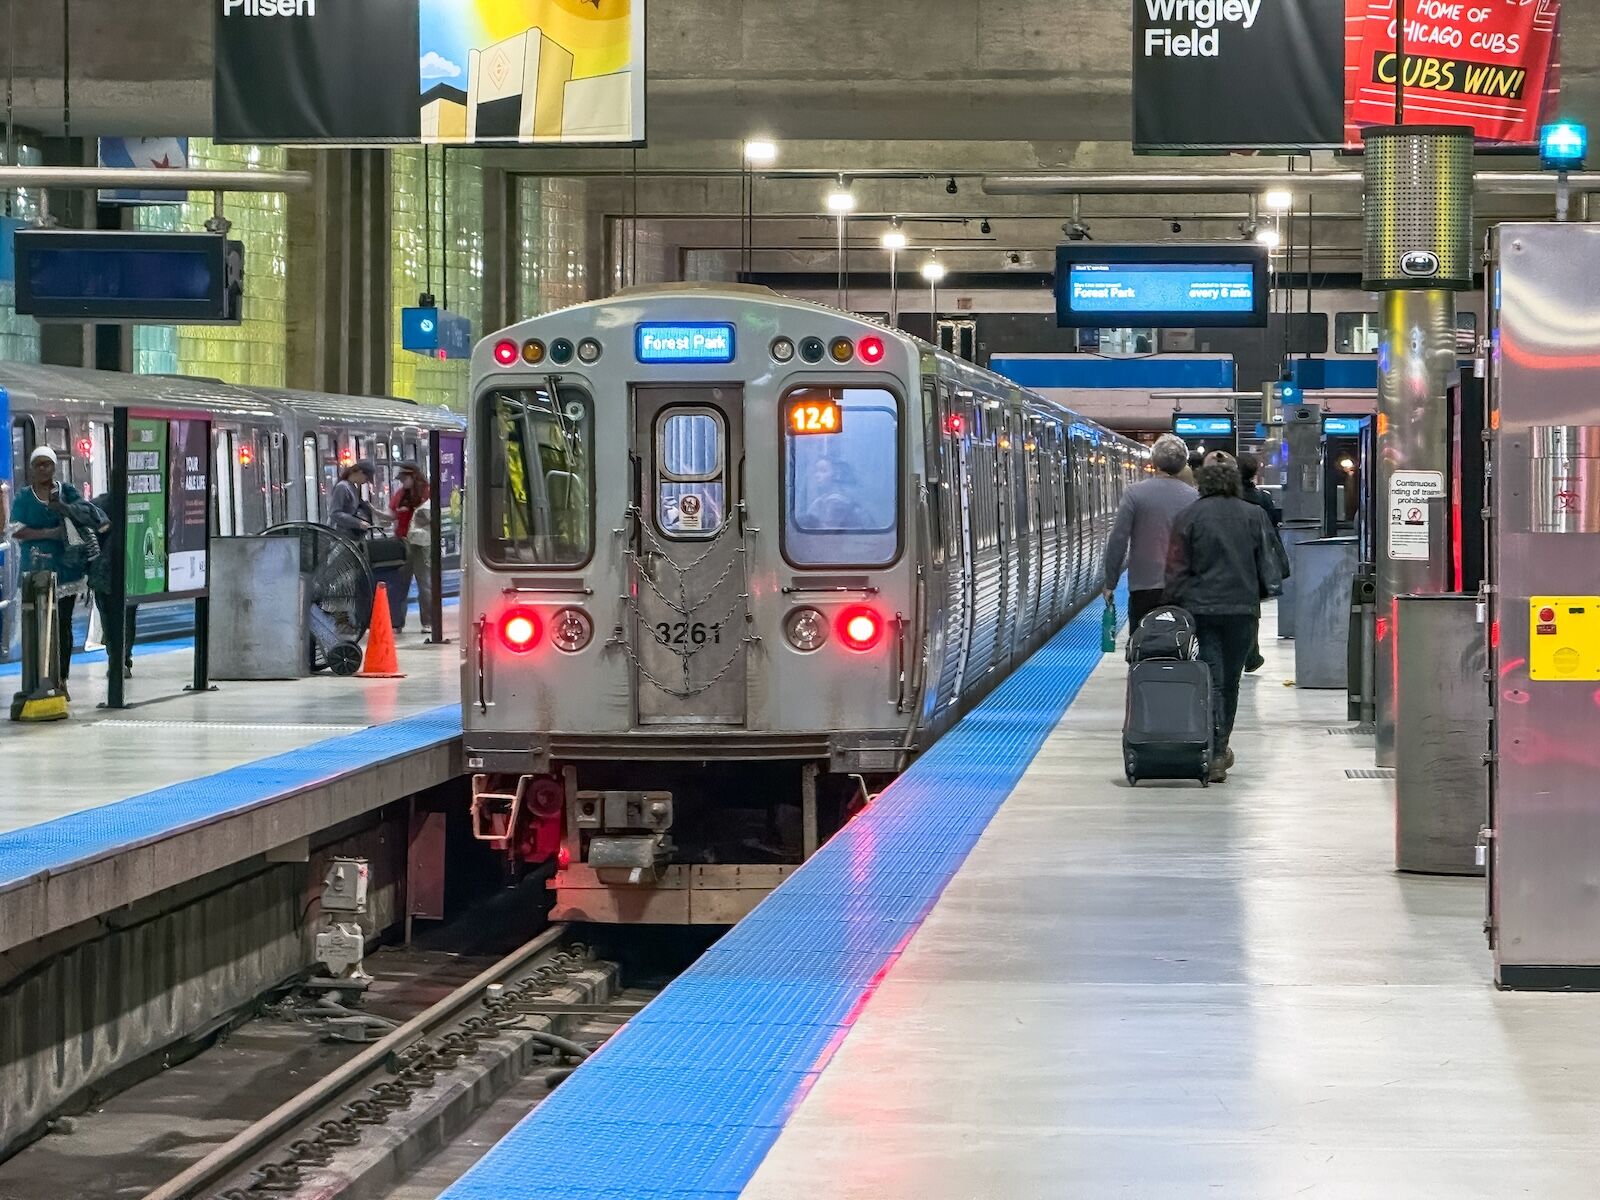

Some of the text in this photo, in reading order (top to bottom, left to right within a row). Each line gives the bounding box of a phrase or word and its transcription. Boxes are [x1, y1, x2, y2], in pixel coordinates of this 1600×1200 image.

[223, 0, 316, 17] Pilsen
[1144, 0, 1261, 29] Wrigley
[1416, 0, 1492, 23] HOME OF
[1145, 28, 1220, 57] Field
[1387, 19, 1520, 54] CHICAGO CUBS
[1378, 53, 1526, 99] CUBS WIN!
[1074, 287, 1109, 299] Forest
[1110, 287, 1136, 299] Park
[1189, 288, 1218, 301] every
[1231, 286, 1252, 299] min
[643, 334, 726, 351] Forest Park
[793, 406, 835, 430] 124
[1395, 479, 1437, 488] Continuous
[656, 622, 720, 645] 3261
